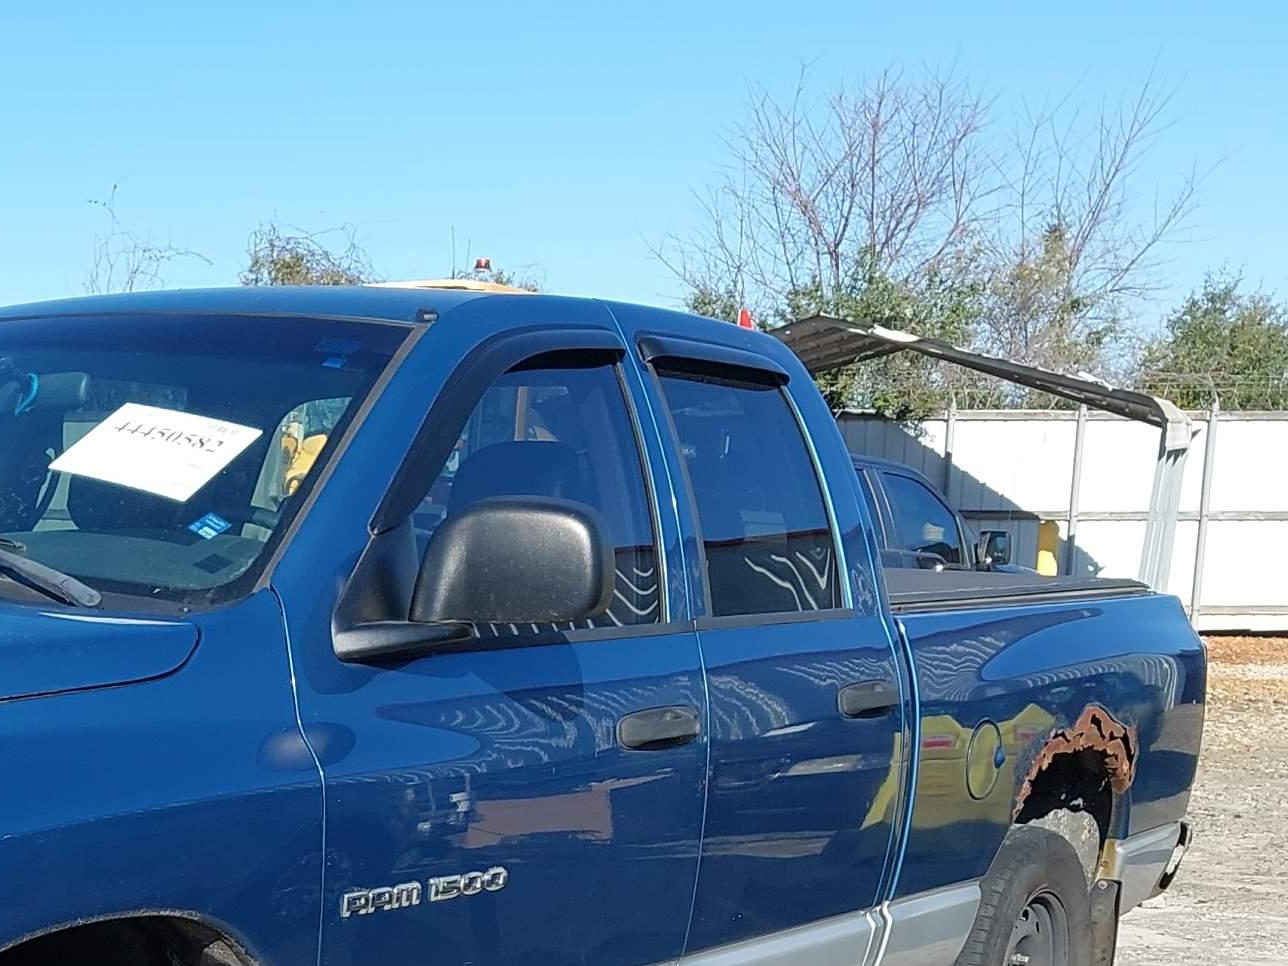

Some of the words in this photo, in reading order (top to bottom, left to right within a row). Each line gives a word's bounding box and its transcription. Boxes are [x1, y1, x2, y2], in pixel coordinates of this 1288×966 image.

[114, 421, 224, 453] 44450582
[341, 881, 423, 919] RAM
[427, 866, 509, 902] 1500
